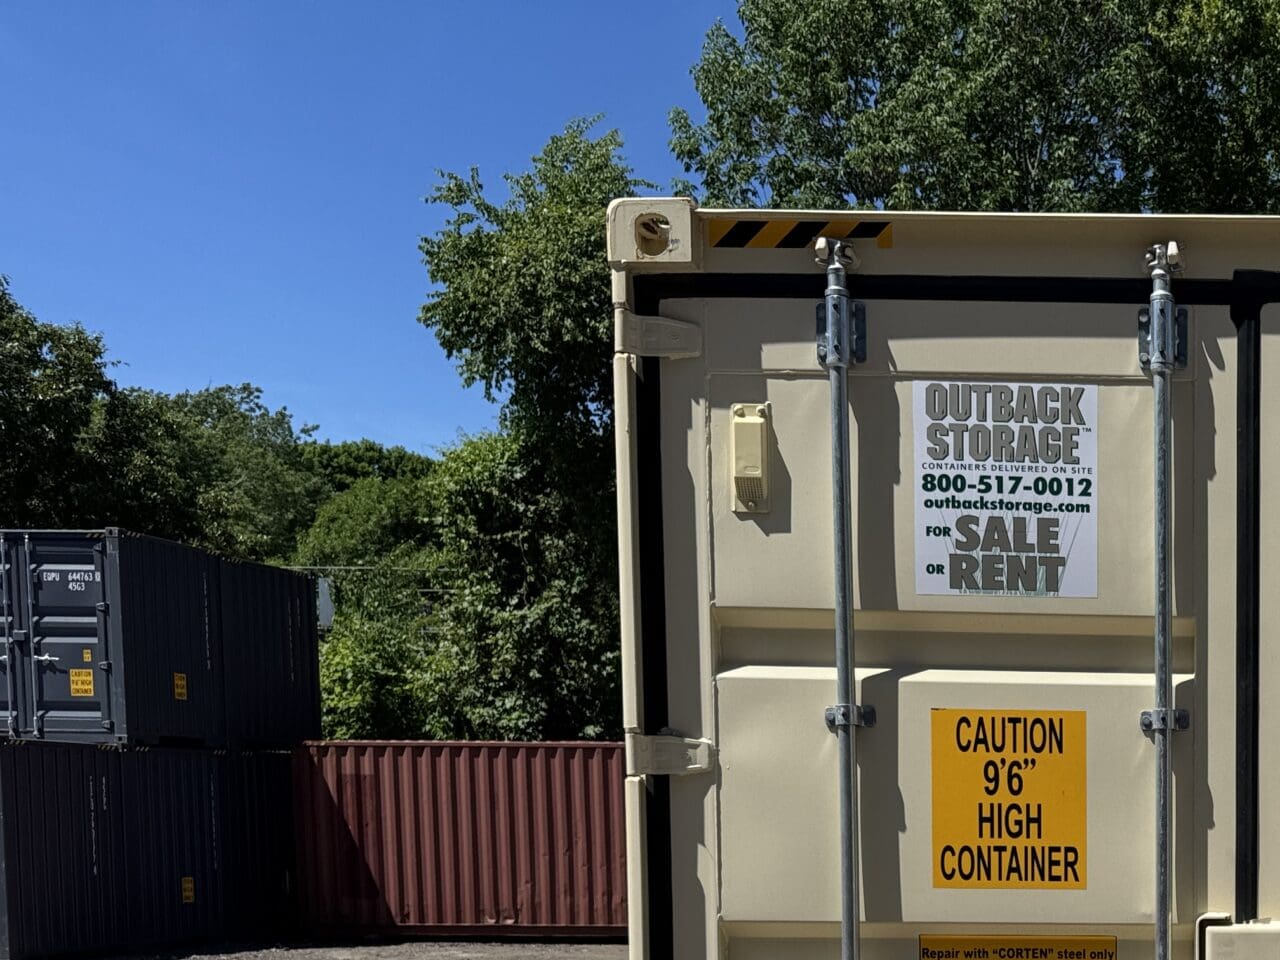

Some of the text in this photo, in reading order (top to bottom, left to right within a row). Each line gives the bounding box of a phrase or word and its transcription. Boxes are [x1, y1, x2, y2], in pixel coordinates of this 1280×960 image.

[925, 383, 1086, 425] OUTBACK
[922, 462, 1093, 475] CONTAINERS DELIVERED ON SITE
[922, 474, 1092, 497] 800-517-0012
[924, 496, 1091, 514] outbackstorage.com
[926, 514, 1060, 554] FOR SALE
[926, 553, 1066, 592] OR RENT
[955, 716, 1063, 754] CAUTION
[978, 803, 1042, 839] HIGH
[940, 845, 1080, 882] CONTAINER
[922, 948, 960, 960] Repair
[963, 948, 989, 959] with
[1057, 949, 1086, 960] steel
